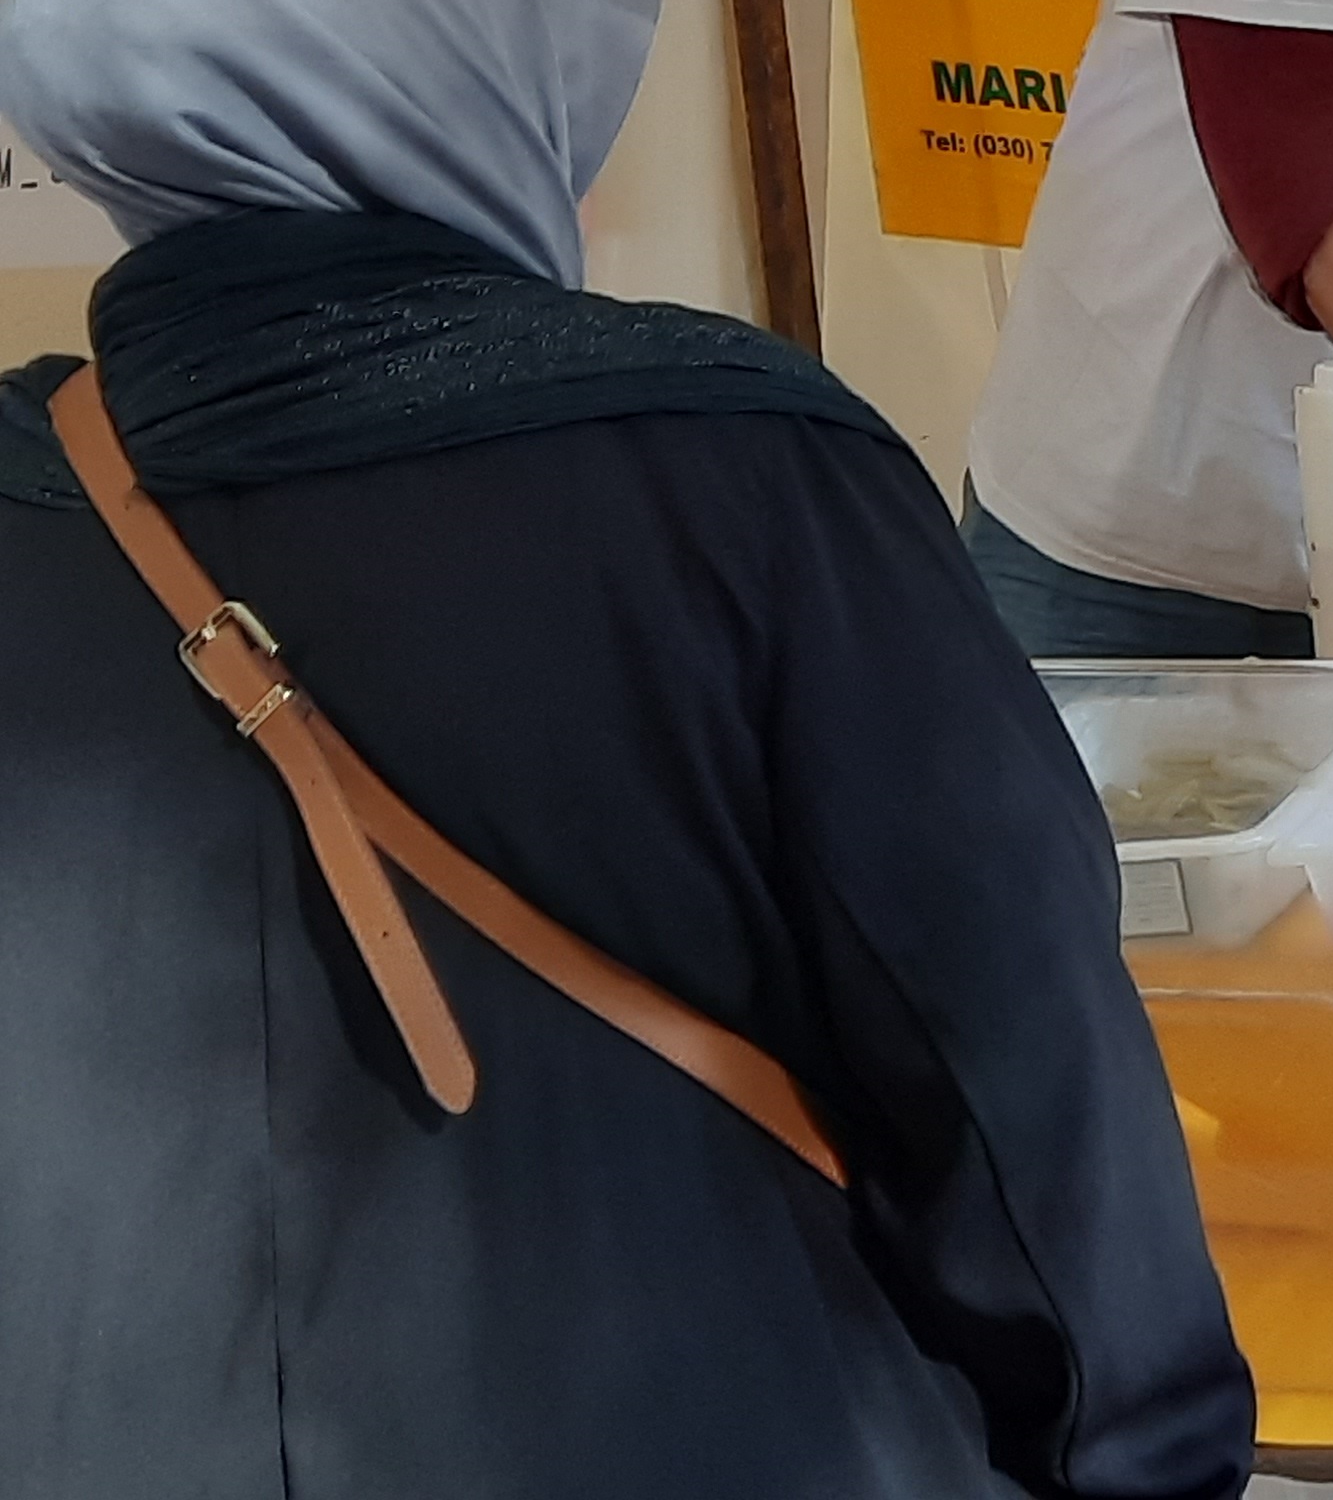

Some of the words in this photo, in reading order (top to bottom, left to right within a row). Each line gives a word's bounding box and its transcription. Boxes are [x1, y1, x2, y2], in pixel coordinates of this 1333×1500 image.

[931, 59, 1067, 114] MARI
[919, 129, 966, 153] Tel:
[973, 133, 1034, 165] (030)
